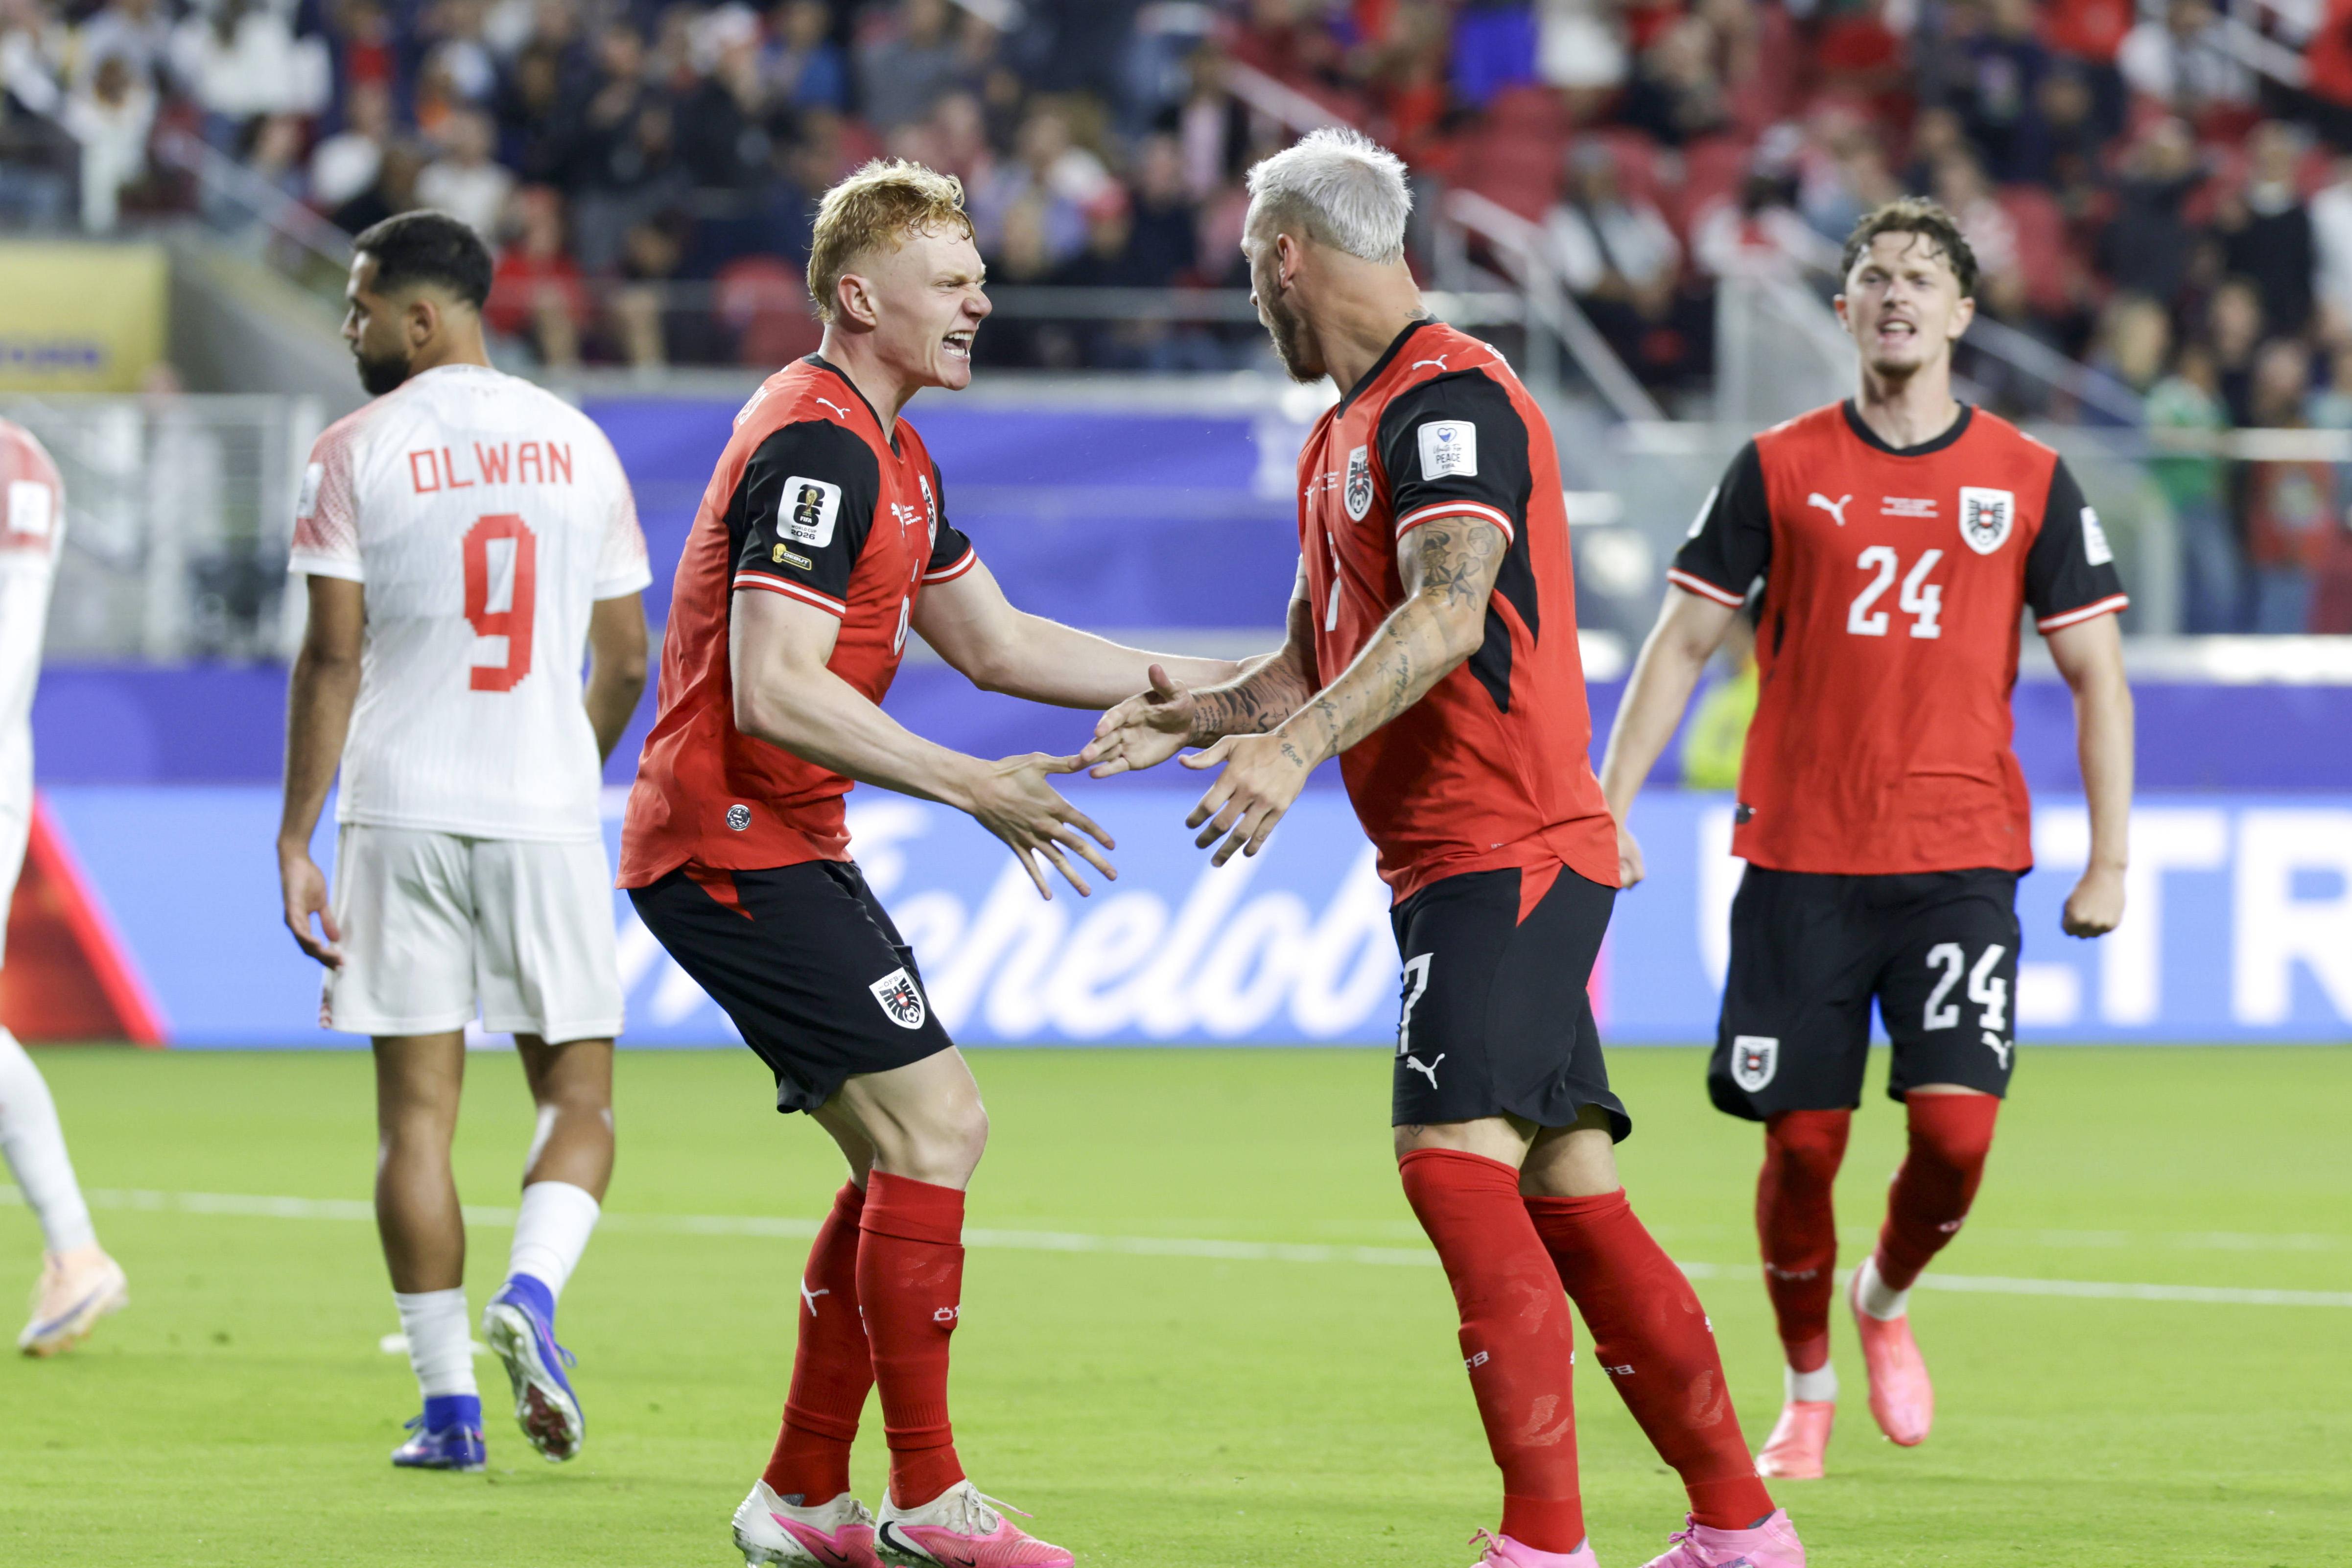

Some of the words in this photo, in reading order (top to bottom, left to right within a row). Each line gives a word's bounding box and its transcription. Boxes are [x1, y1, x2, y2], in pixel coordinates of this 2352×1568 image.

[408, 440, 573, 494] OLWAN
[1436, 453, 1461, 464] PEACE
[791, 529, 816, 540] 2026
[800, 515, 813, 524] FIFA
[784, 552, 809, 564] DEBUT
[463, 514, 536, 692] 9
[1847, 545, 1944, 640] 24
[1400, 952, 1435, 1054] 7
[1923, 942, 2007, 1032] 24
